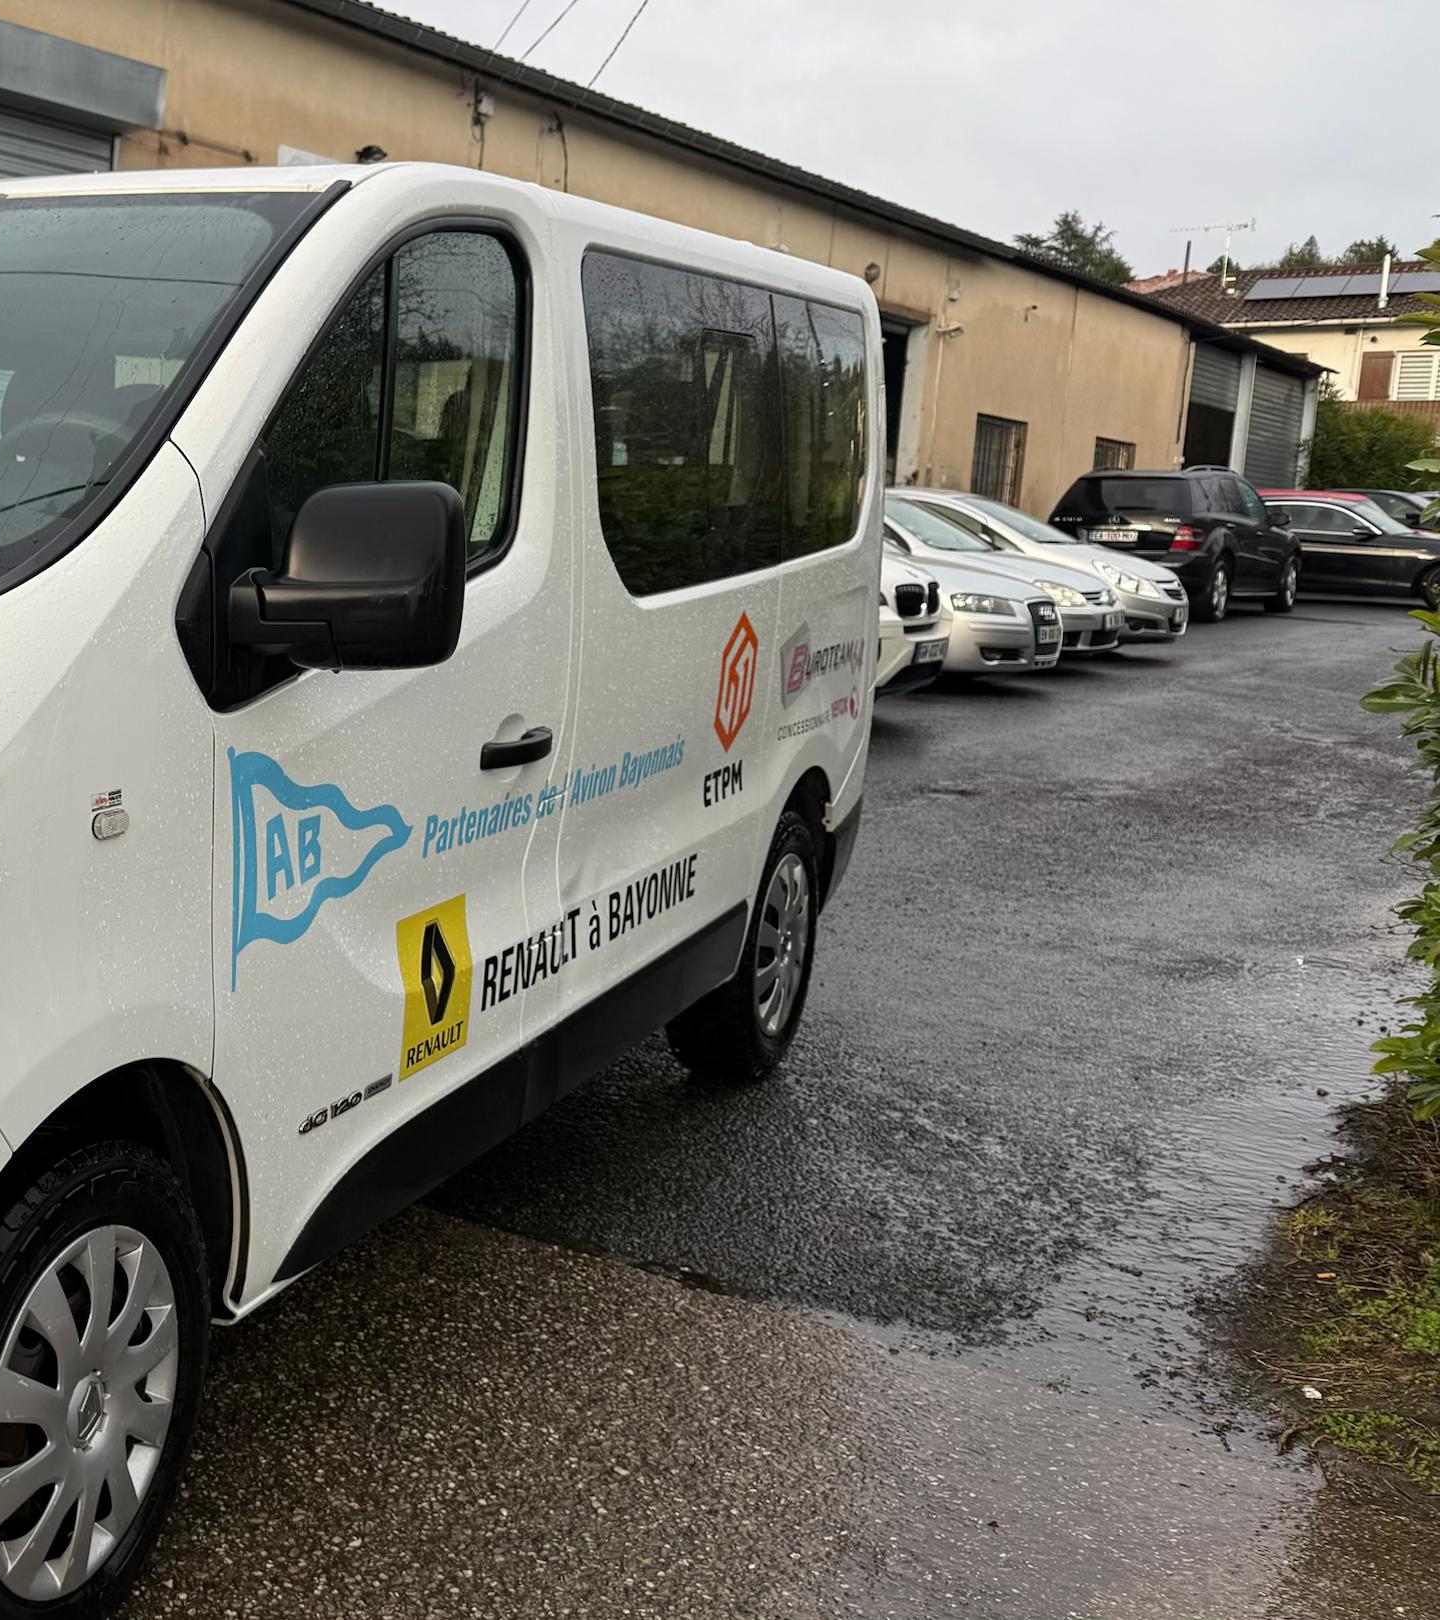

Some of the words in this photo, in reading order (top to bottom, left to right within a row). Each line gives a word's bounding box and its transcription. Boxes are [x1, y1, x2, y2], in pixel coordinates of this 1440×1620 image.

[422, 792, 532, 859] Partenaires
[536, 780, 557, 820] de
[618, 734, 686, 789] Bayonnais
[704, 759, 743, 807] ETPM
[265, 812, 322, 902] AB
[481, 907, 581, 1012] RENAULT
[589, 900, 601, 950] à
[609, 853, 698, 941] BAYONNE
[406, 1021, 464, 1069] RENAULT
